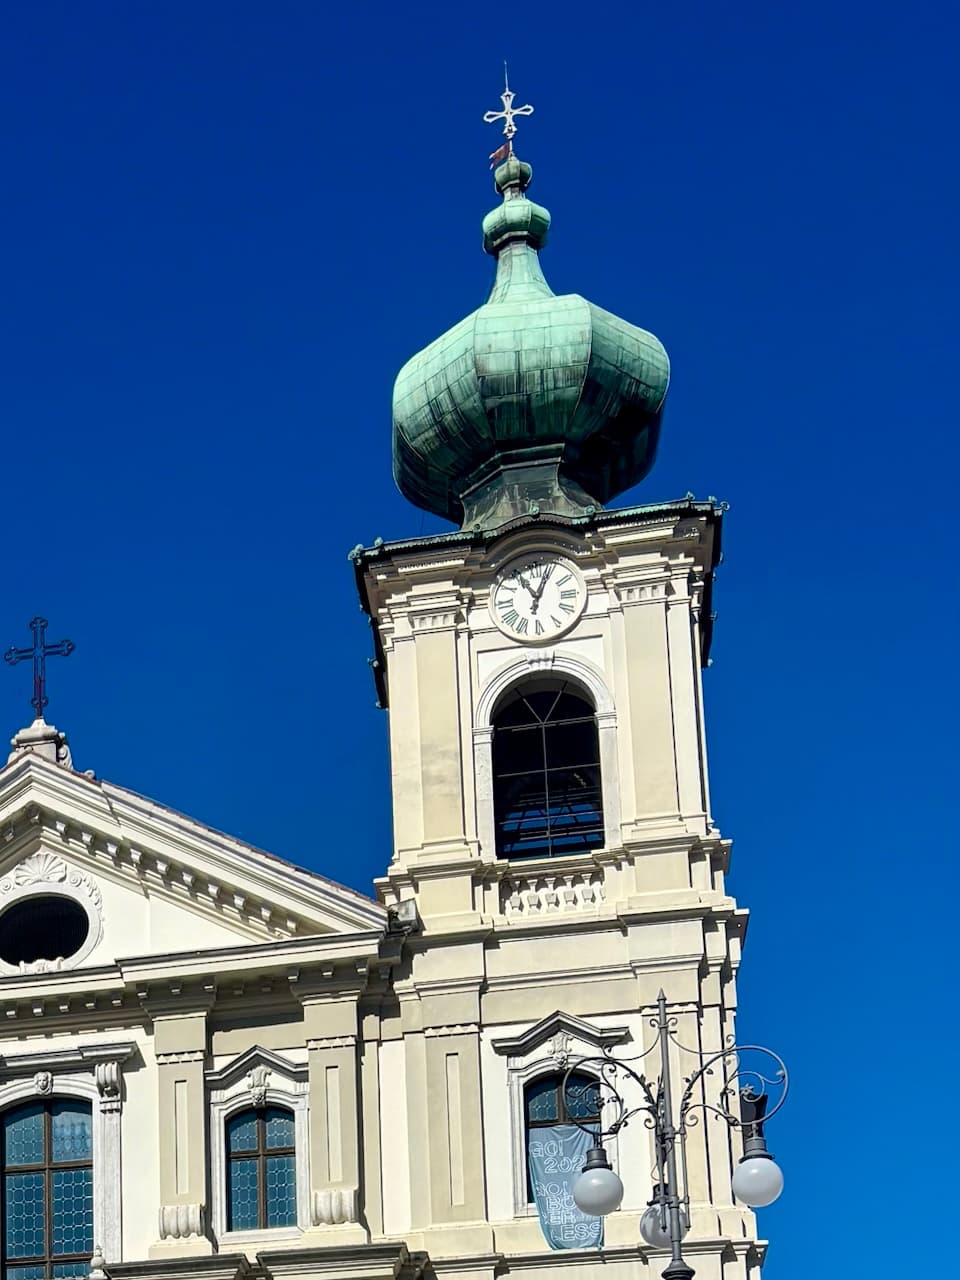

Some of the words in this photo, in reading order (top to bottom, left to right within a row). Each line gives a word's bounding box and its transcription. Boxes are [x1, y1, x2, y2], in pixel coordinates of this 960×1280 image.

[530, 1140, 564, 1158] GO!
[544, 1154, 587, 1174] 202
[546, 1195, 577, 1211] BO
